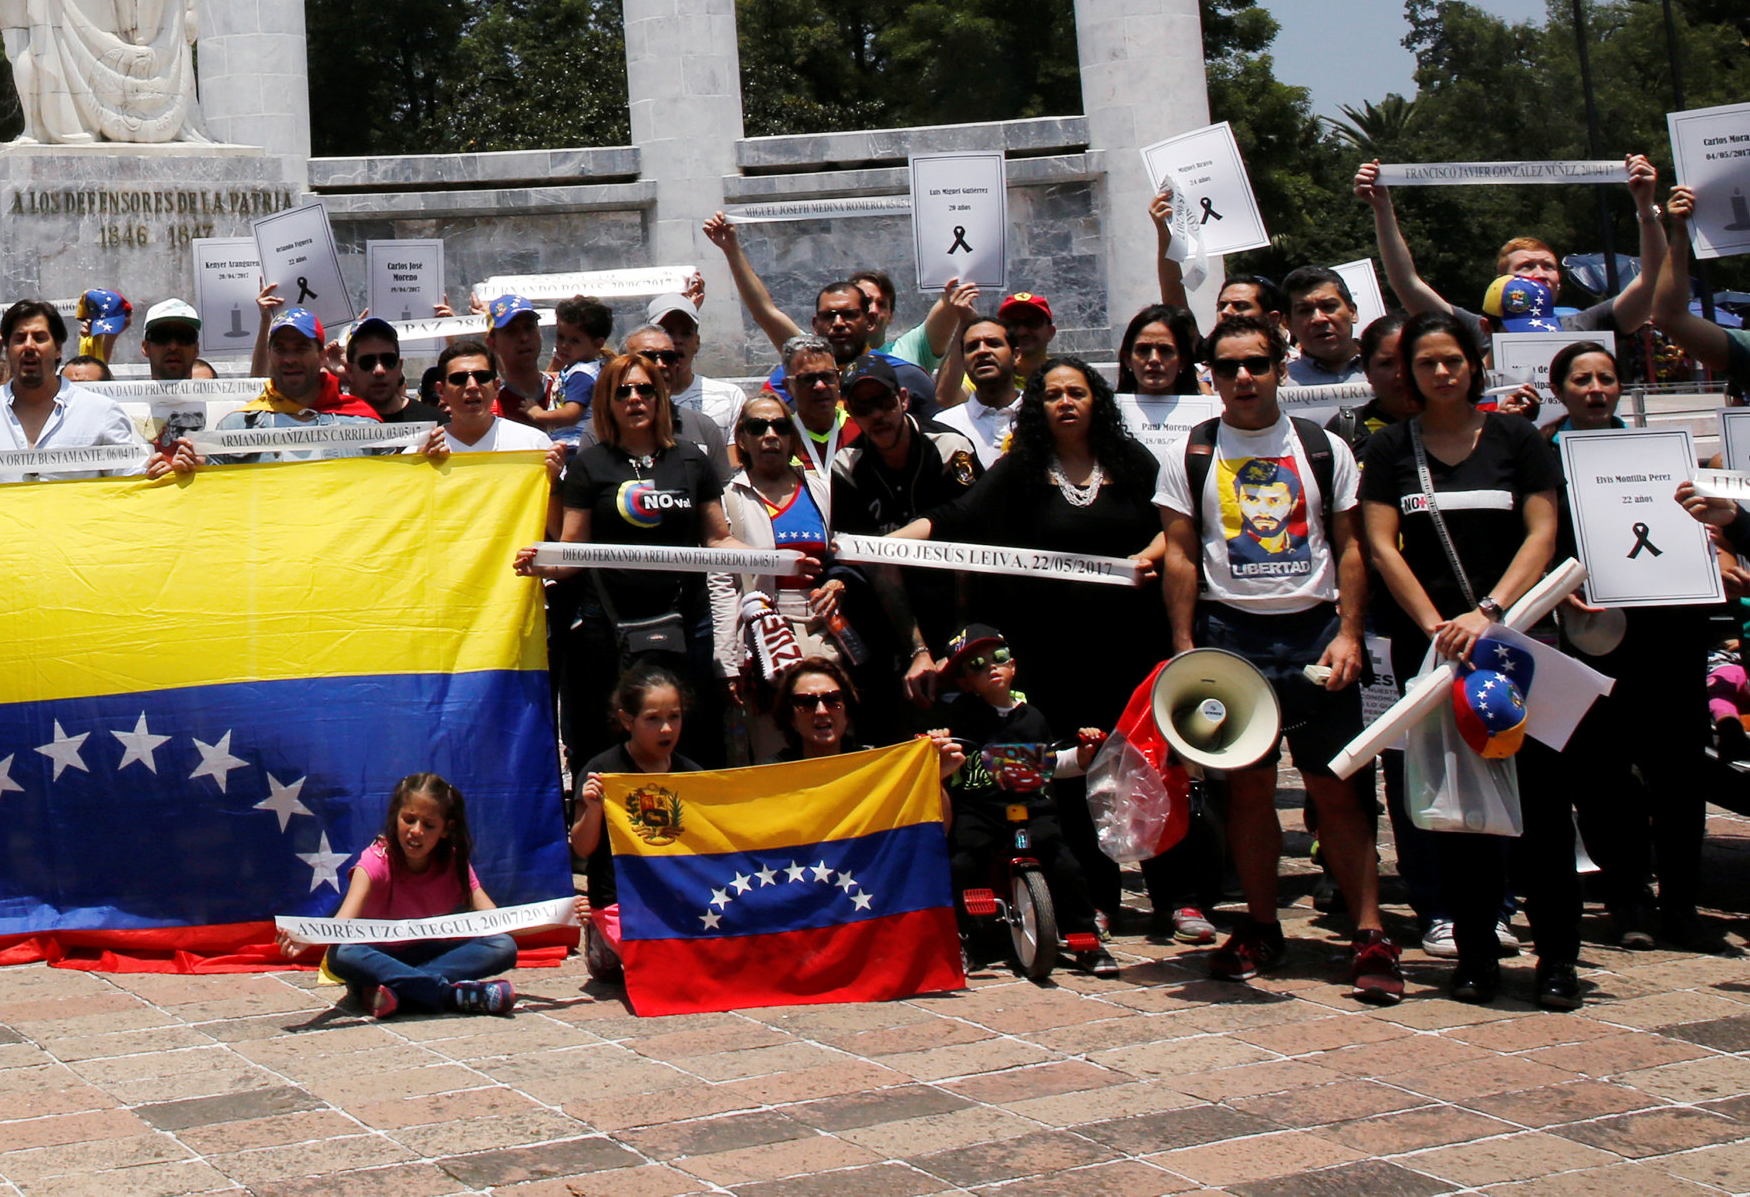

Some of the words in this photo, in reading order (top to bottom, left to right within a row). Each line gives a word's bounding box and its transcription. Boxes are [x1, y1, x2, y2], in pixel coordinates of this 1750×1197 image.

[1704, 136, 1728, 146] Carlos
[1405, 166, 1457, 180] FRANCISCO
[1458, 165, 1491, 179] JAVIER
[1493, 162, 1544, 178] GONZÁLEZ
[1545, 162, 1581, 178] NÚÑEZ,
[11, 192, 24, 214] A
[29, 191, 60, 214] LOS
[66, 191, 174, 214] DEFENSORES
[177, 191, 197, 214] DE
[200, 191, 225, 214] LA
[229, 191, 293, 214] PATRIA
[744, 205, 778, 218] MIGUEL
[778, 203, 811, 216] JOSEPH
[811, 202, 846, 215] MEDINA
[846, 200, 886, 213] ROMERO,
[100, 224, 148, 249] 1846
[387, 262, 407, 271] Carlos
[408, 260, 423, 271] José
[393, 272, 418, 282] Moreno
[116, 383, 143, 396] DAVID
[144, 381, 192, 396] PRINCIPAL
[1331, 386, 1367, 401] VERA
[1163, 422, 1193, 432] Moreno
[221, 434, 271, 447] ARMANDO
[272, 428, 329, 445] CAÑIZALES
[330, 426, 385, 442] CARRILLO,
[386, 426, 422, 440] 03/05/17
[6, 453, 35, 467] ORTIZ
[38, 450, 105, 466] BUSTAMANTE,
[106, 447, 140, 462] 06/04/17
[1596, 474, 1614, 485] Elvis
[1615, 473, 1647, 484] Montilla
[1648, 471, 1672, 483] Pérez
[644, 493, 673, 510] NO
[1621, 495, 1633, 504] 22
[1633, 494, 1654, 504] años
[562, 548, 592, 562] DIEGO
[593, 549, 641, 564] FERNANDO
[642, 551, 692, 565] ARELLANO
[694, 552, 748, 568] FIGUEREDO,
[749, 554, 780, 568] 16/05/17
[853, 540, 909, 558] YNIGO
[912, 544, 964, 563] JESÚS
[969, 550, 1027, 571] LEIVA,
[1031, 555, 1113, 577] 22/05/2017
[1231, 560, 1311, 576] LIBERTAD
[296, 919, 366, 939] ANDRÉS
[370, 917, 480, 939] UZCÁTEGUI,
[482, 904, 560, 930] 20/07/2017
